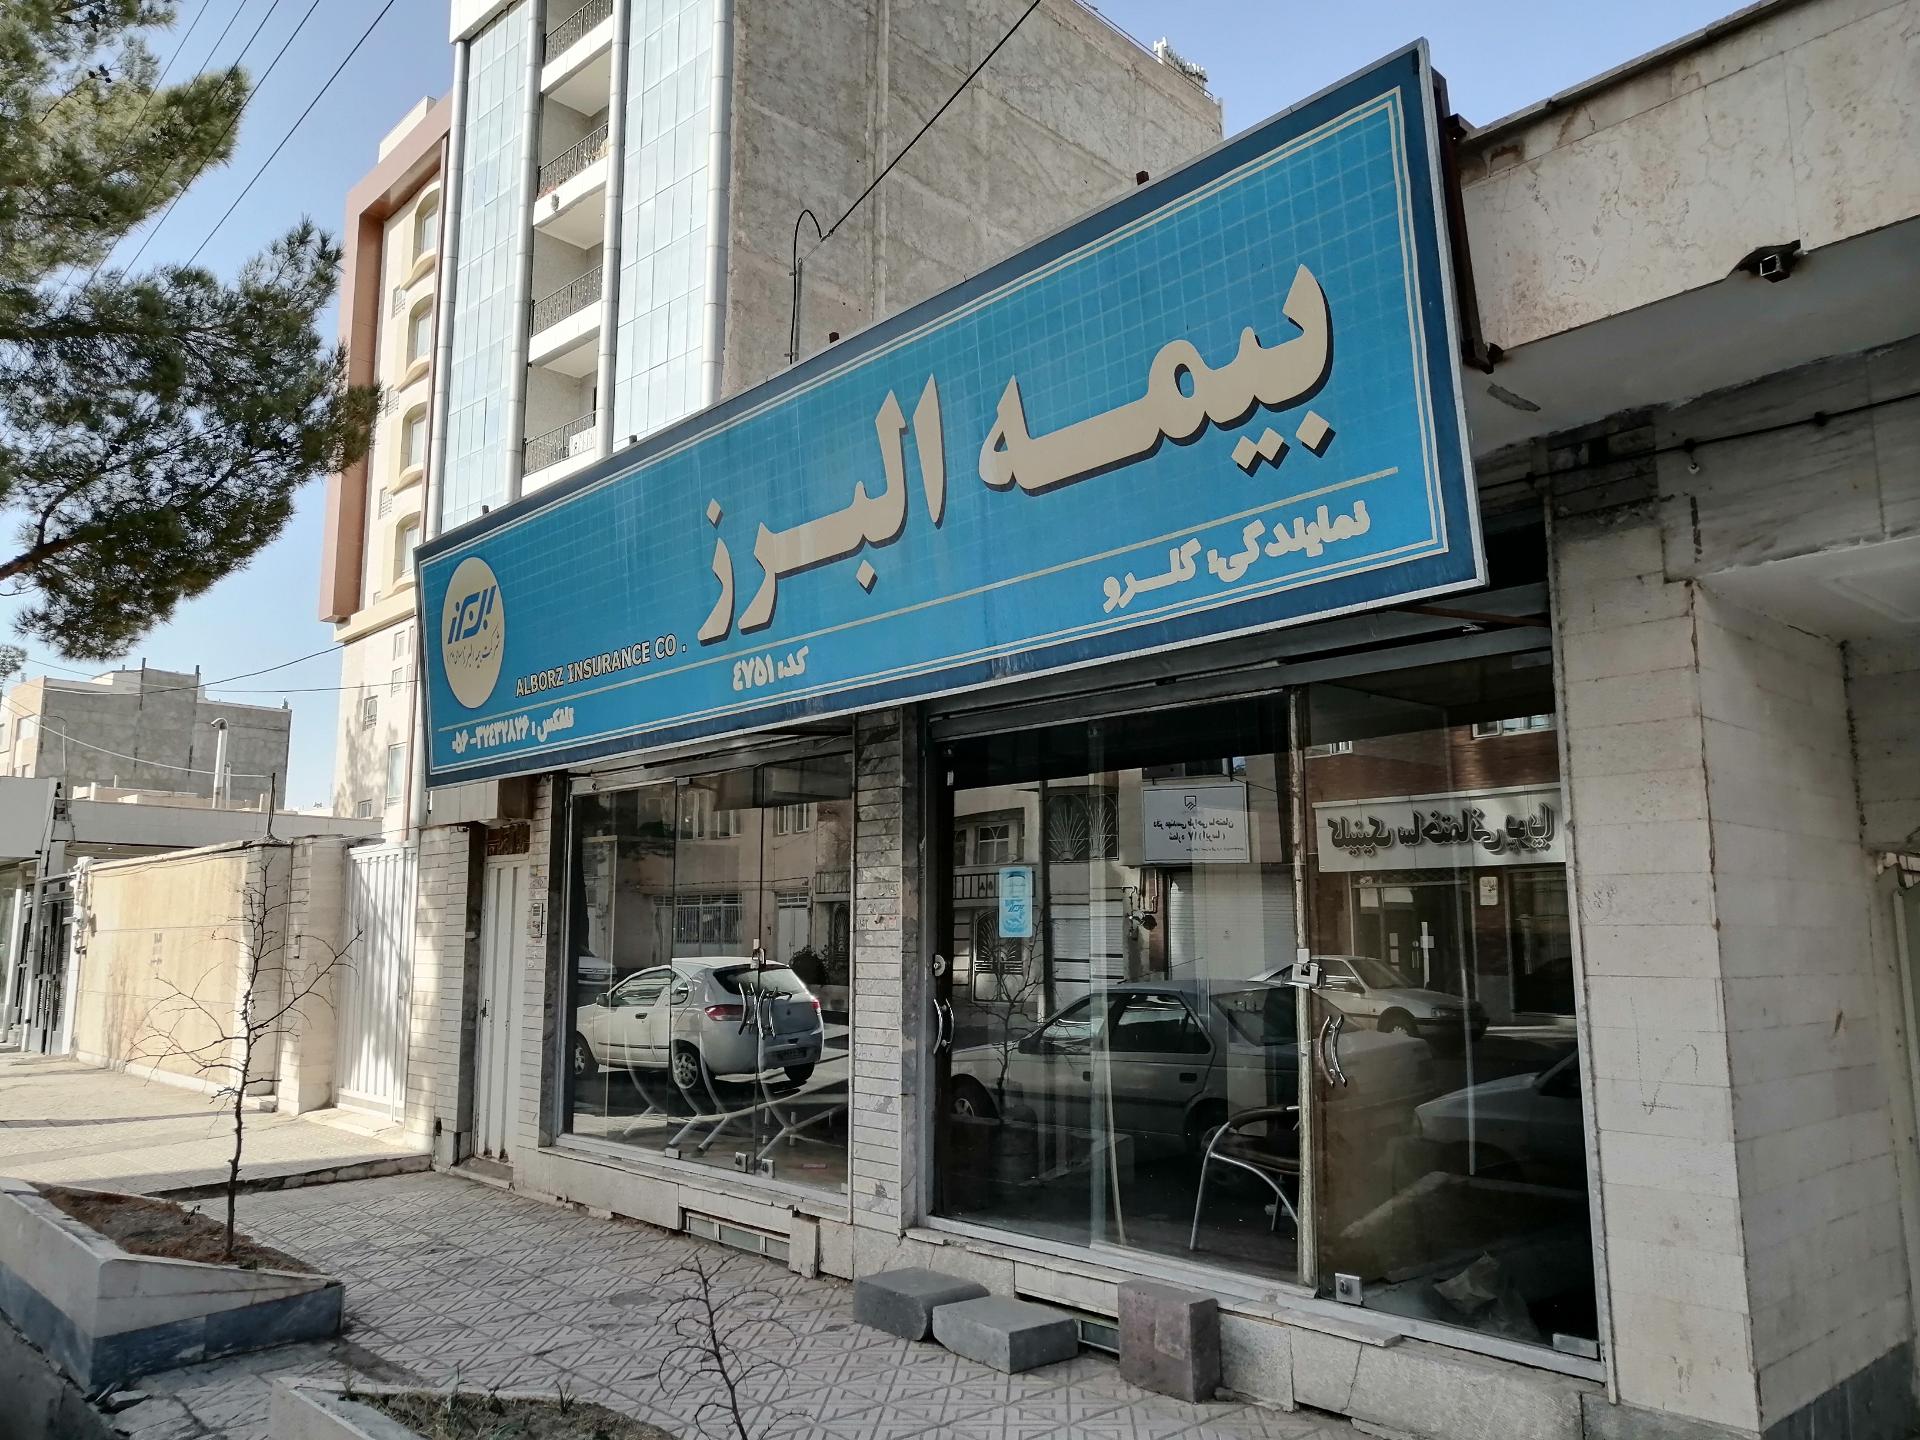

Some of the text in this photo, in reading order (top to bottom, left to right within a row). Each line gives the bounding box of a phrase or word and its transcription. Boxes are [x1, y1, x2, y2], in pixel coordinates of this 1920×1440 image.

[697, 263, 1334, 644] بیمه البرز
[1103, 537, 1202, 613] گلرو
[516, 665, 564, 698] ALBORZ
[567, 640, 651, 684] INSURANCE
